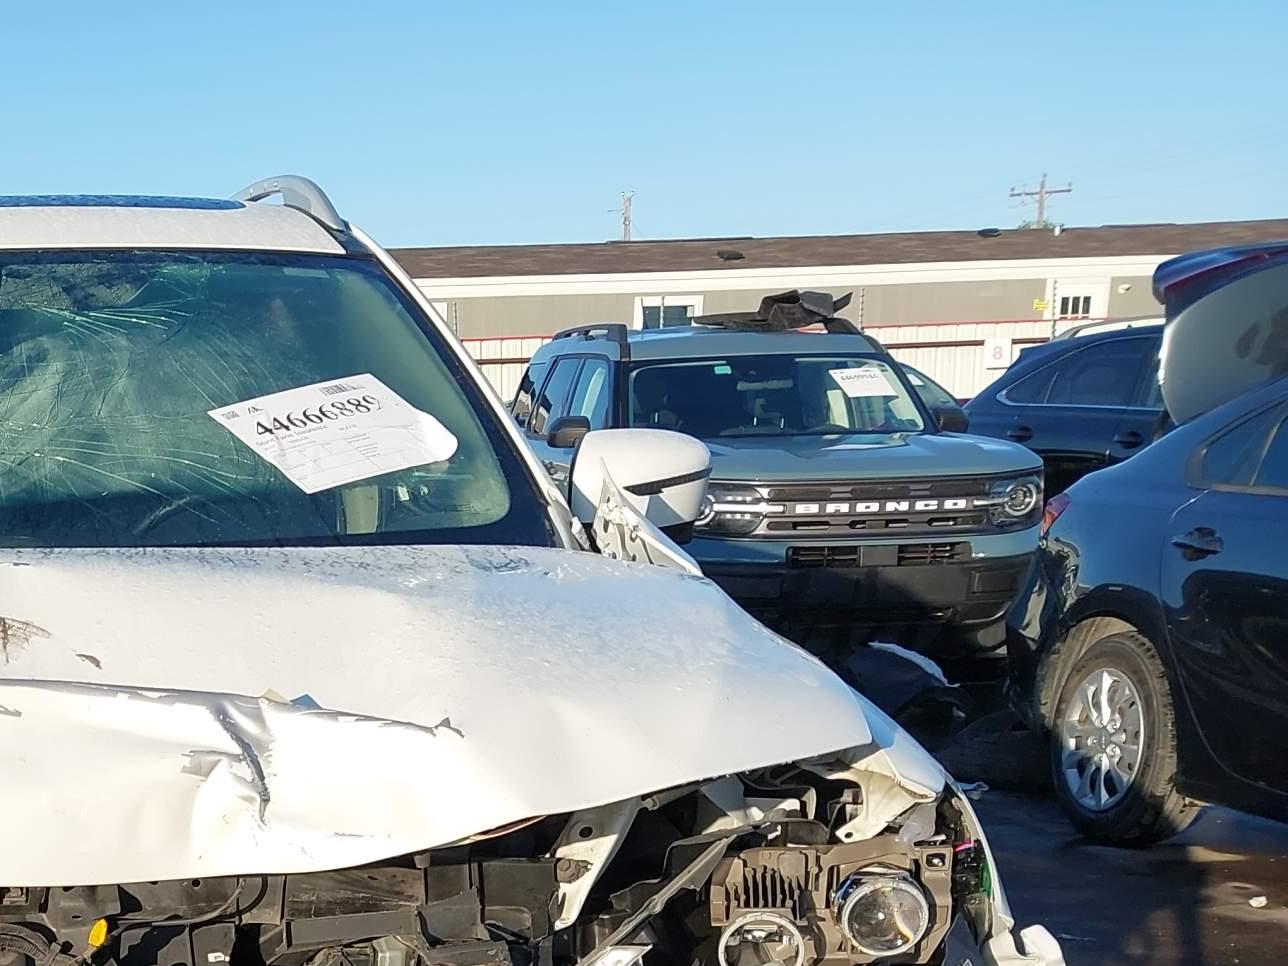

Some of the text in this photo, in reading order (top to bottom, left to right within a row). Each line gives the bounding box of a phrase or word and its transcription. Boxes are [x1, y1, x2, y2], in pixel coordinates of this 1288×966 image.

[993, 346, 1002, 360] 8
[256, 394, 383, 436] 44666889
[795, 499, 966, 513] BRONCO
